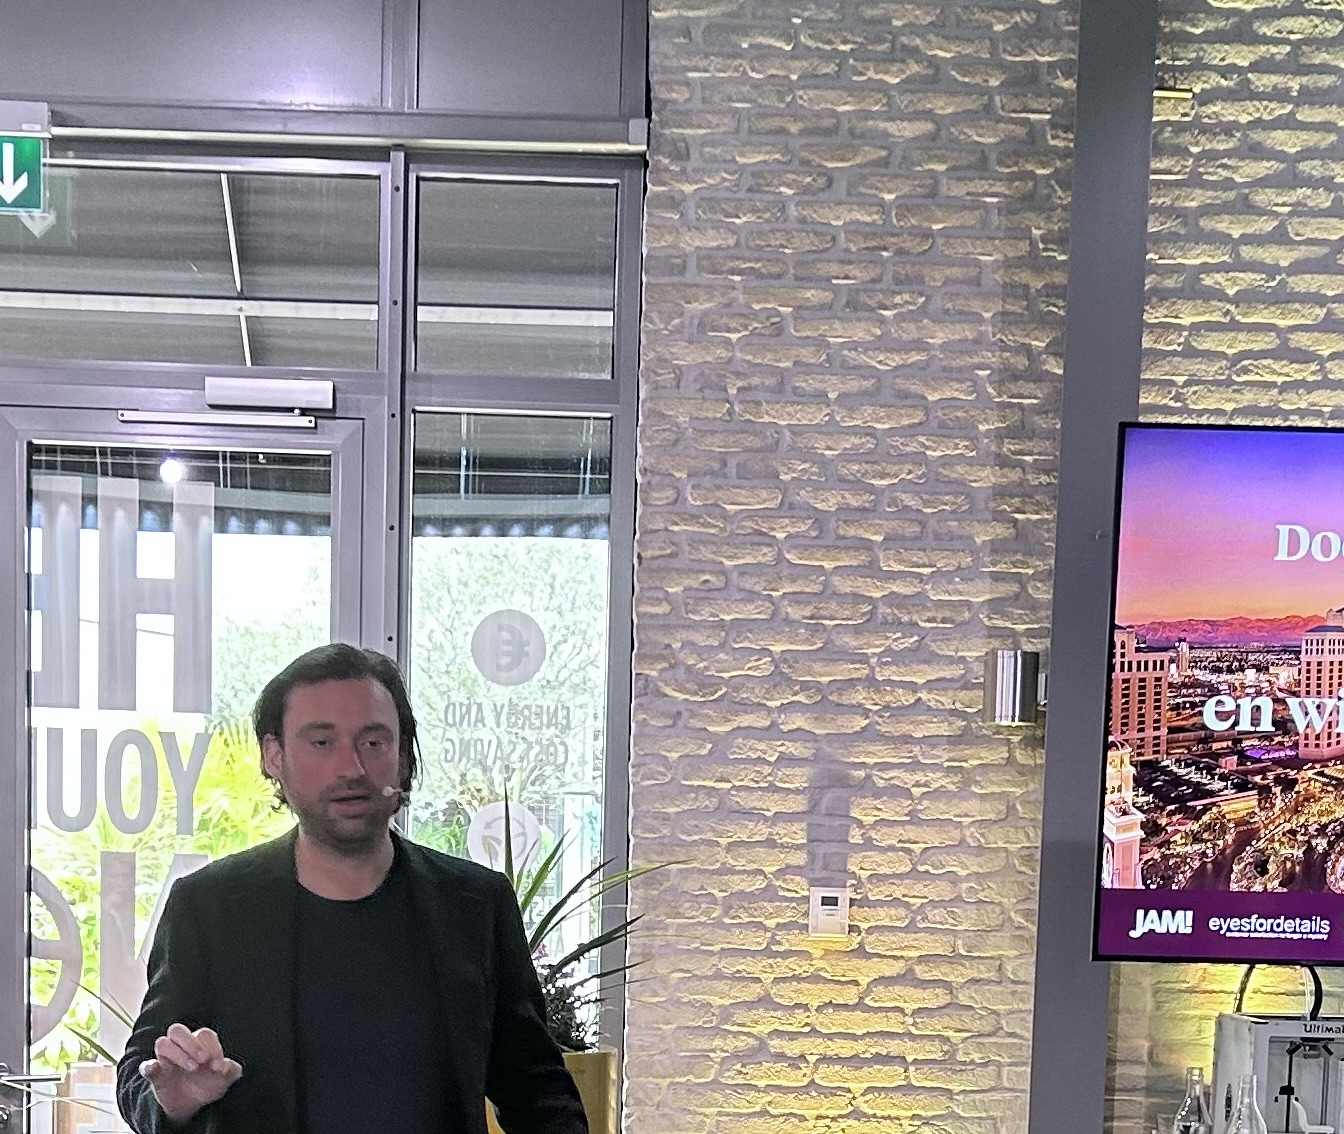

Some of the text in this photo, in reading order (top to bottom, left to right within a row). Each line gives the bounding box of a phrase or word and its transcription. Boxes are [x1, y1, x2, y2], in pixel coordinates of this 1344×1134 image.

[1203, 696, 1274, 732] en
[1128, 909, 1194, 938] JAM!
[1208, 913, 1331, 934] eyesfordetails
